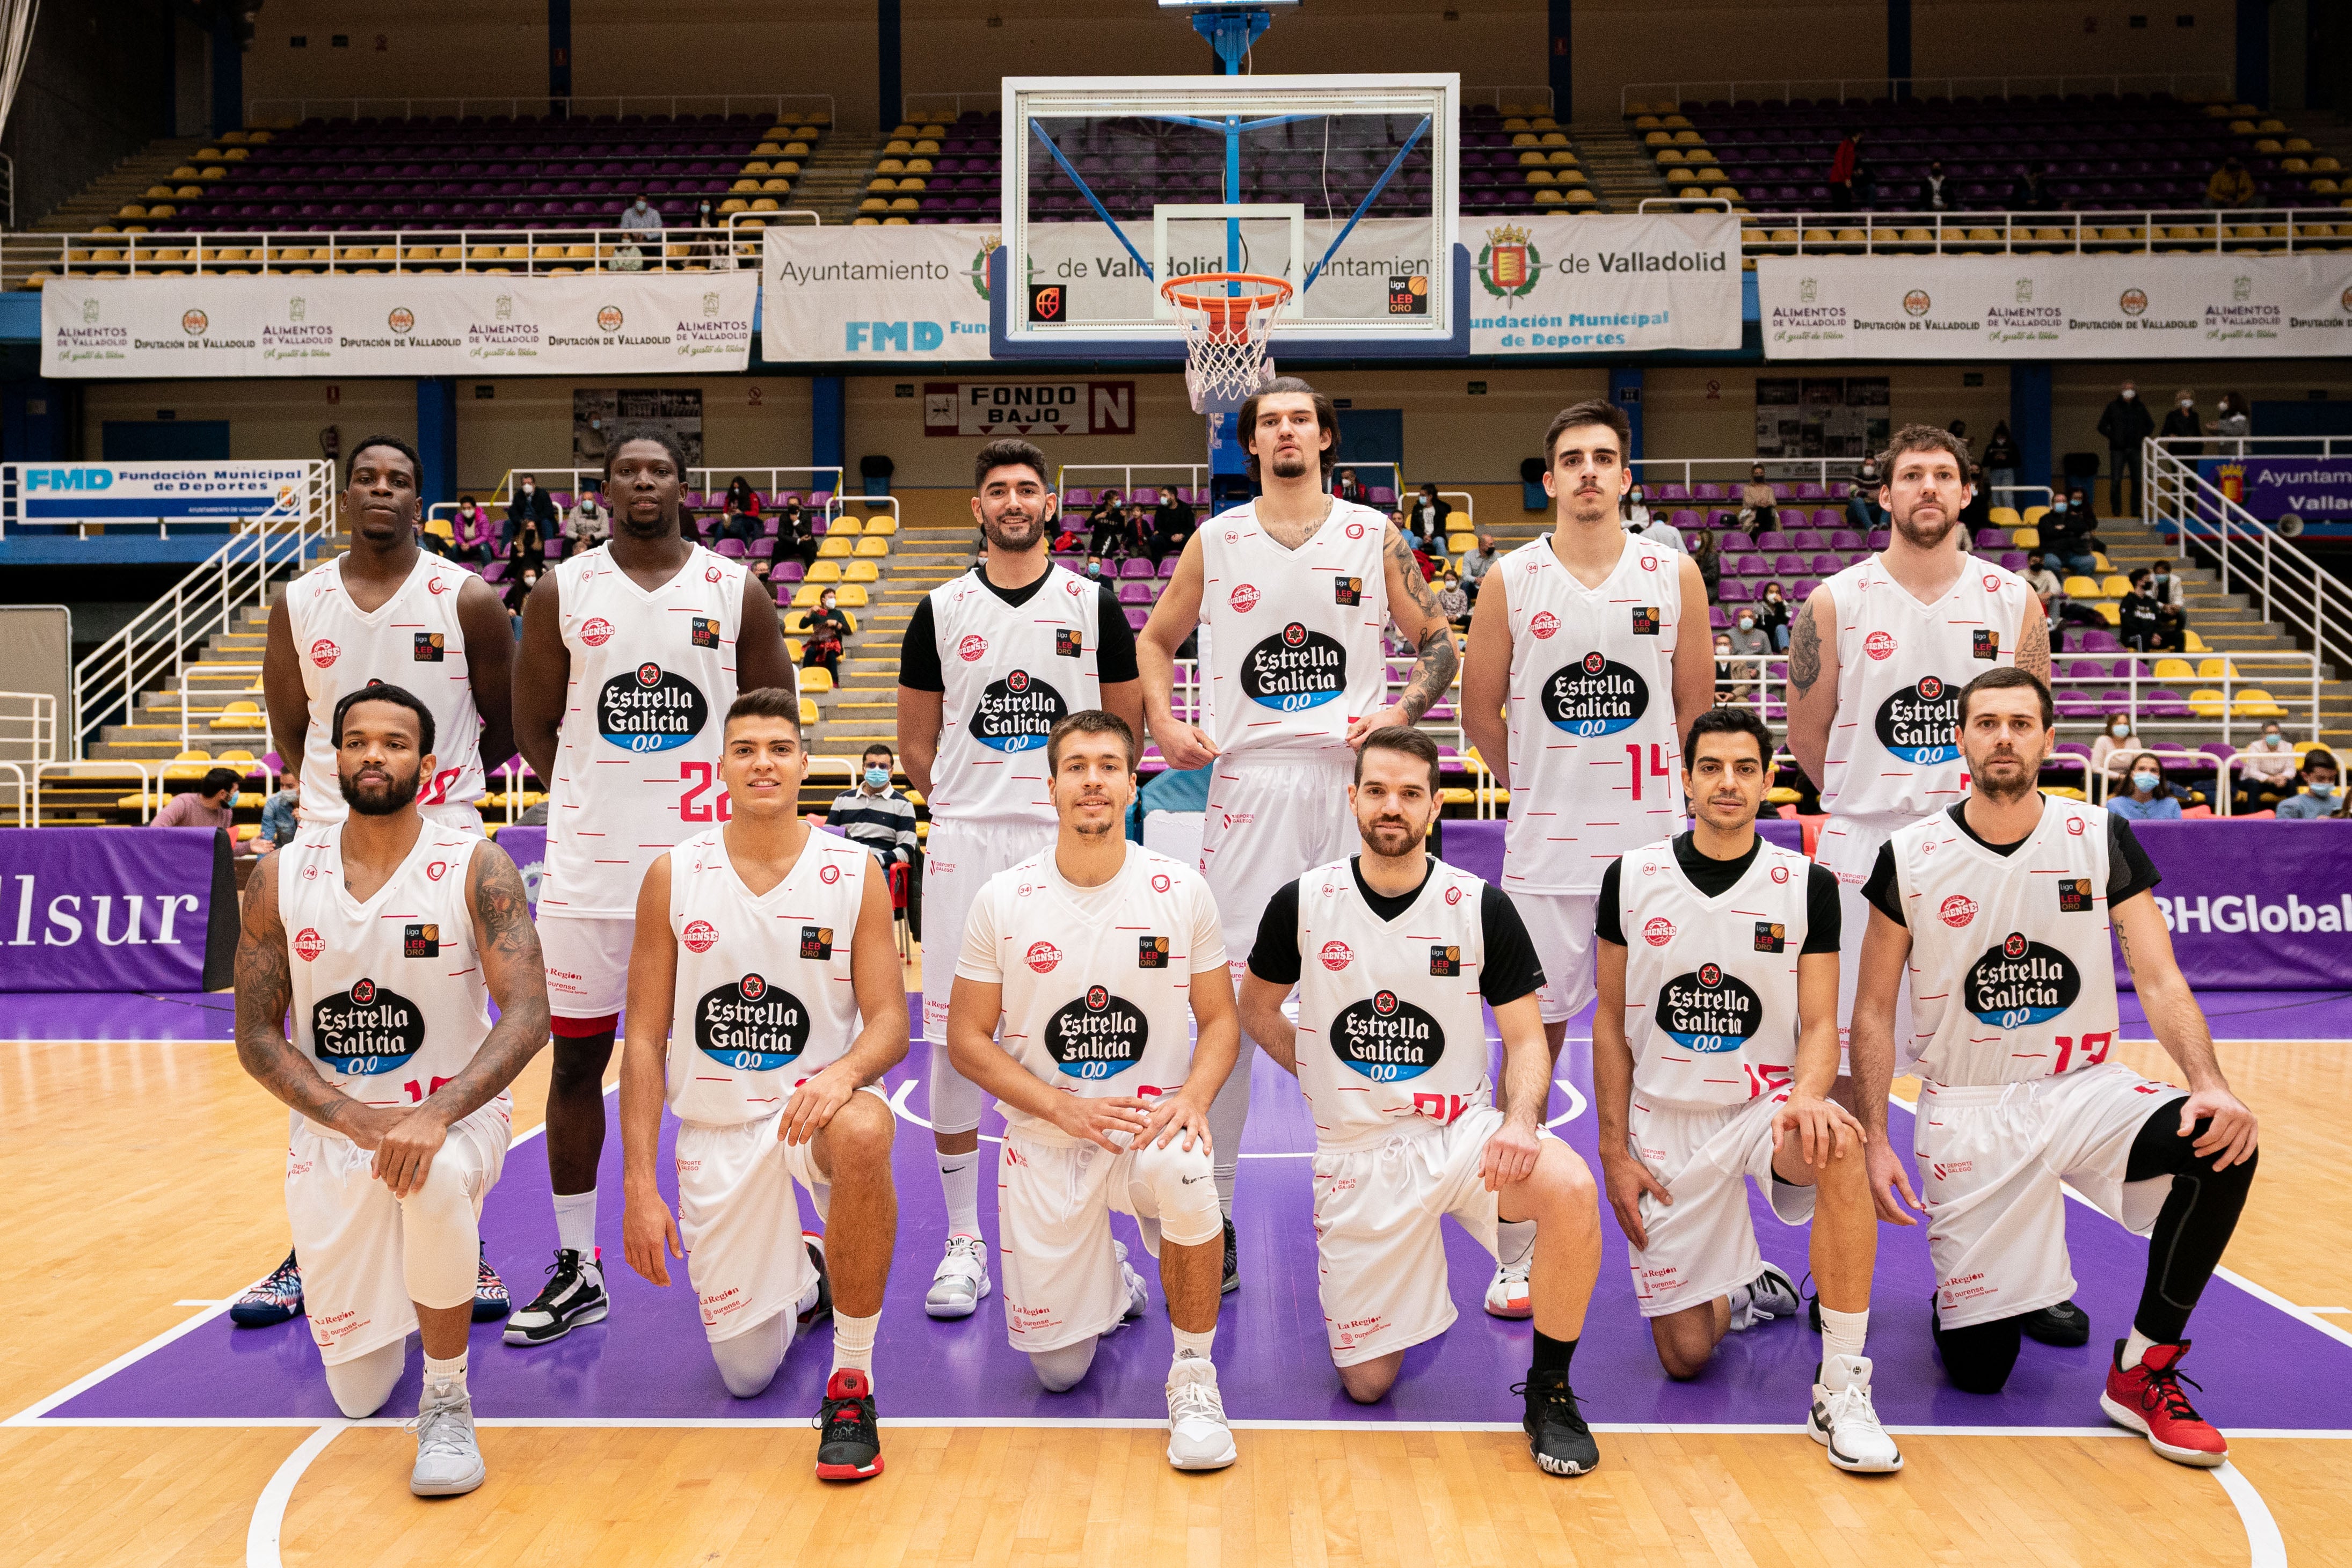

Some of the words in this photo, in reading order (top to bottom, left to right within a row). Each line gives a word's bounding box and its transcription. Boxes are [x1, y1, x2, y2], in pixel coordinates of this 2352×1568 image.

[780, 261, 949, 287] Ayuntamiento
[1058, 259, 1087, 278] de
[1560, 254, 1590, 274] de
[1598, 251, 1726, 273] Valladolid
[1390, 281, 1405, 290] Liga
[1390, 294, 1413, 303] LEB
[1470, 313, 1562, 329] undación
[1570, 311, 1669, 328] Municipal
[1773, 307, 1846, 317] ALIMENTOS
[1987, 307, 2062, 317] ALIMENTOS
[263, 325, 333, 335] ALIMENTOS
[469, 324, 538, 333] ALIMENTOS
[676, 321, 747, 331] ALIMENTOS
[846, 322, 944, 352] FMD
[1501, 333, 1526, 347] de
[1532, 332, 1625, 349] Deportes
[971, 386, 1076, 406] FONDO
[1094, 388, 1128, 428] N
[988, 409, 1060, 424] BAJO
[26, 469, 113, 492] FMD
[119, 471, 207, 480] Fundación
[214, 470, 301, 483] Municipal
[154, 482, 174, 491] de
[179, 482, 268, 494] Deportes
[1254, 646, 1339, 672] Estrella
[1258, 669, 1336, 694] Galicia
[1554, 675, 1635, 697] Estrella
[604, 686, 694, 709] Estrella
[979, 692, 1056, 713] Estrella
[1558, 697, 1632, 718] Galicia
[608, 709, 689, 732] Galicia
[1889, 699, 1959, 722] Estrell
[983, 712, 1051, 735] Galicia
[1892, 721, 1957, 745] Galici
[1626, 743, 1671, 800] 14
[2061, 895, 2081, 903] LEB
[802, 942, 820, 950] LEB
[1756, 936, 1773, 944] LEB
[1023, 950, 1062, 964] OURENSE
[1317, 950, 1354, 960] OURENSE
[1976, 958, 2063, 988] Estrella
[548, 981, 576, 990] ourense
[1978, 982, 2058, 1010] Galicia
[1667, 986, 1750, 1012] Estrella
[318, 1005, 409, 1030] Estrella
[705, 998, 798, 1026] Estrella
[1672, 1009, 1742, 1035] Galicia
[1059, 1011, 1137, 1037] Estrella
[1344, 1013, 1429, 1040] Estrella
[324, 1029, 406, 1055] Galicia
[710, 1023, 792, 1052] Galicia
[1062, 1035, 1131, 1060] Galicia
[1350, 1037, 1424, 1063] Galicia
[1651, 1279, 1676, 1288] ourense
[1955, 1286, 1984, 1297] ourense
[713, 1300, 740, 1315] ourense
[331, 1322, 357, 1335] ourense
